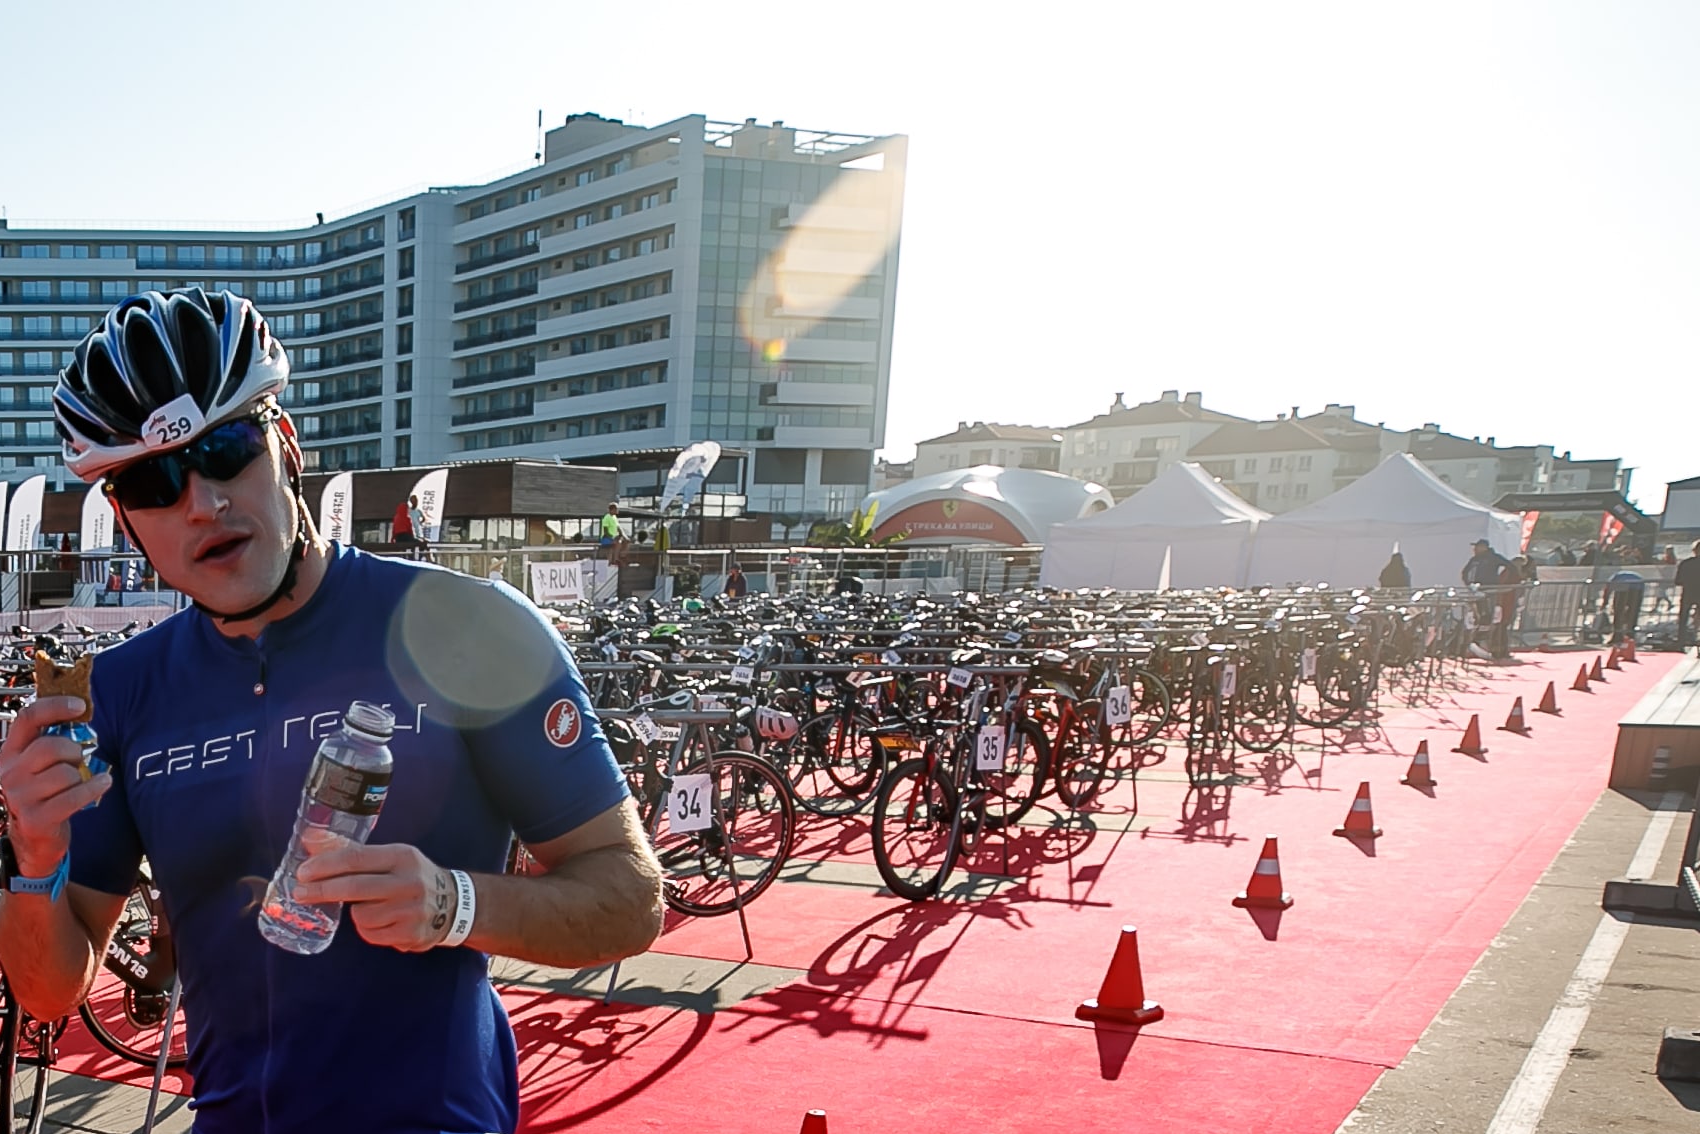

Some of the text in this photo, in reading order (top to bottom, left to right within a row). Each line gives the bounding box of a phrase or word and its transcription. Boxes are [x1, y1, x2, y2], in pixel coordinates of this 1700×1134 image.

[157, 417, 191, 444] 259
[550, 568, 577, 589] RUN
[1110, 694, 1127, 716] 36
[636, 719, 653, 737] 2594
[982, 736, 999, 761] 35
[677, 787, 702, 820] 34
[432, 873, 447, 930] 259
